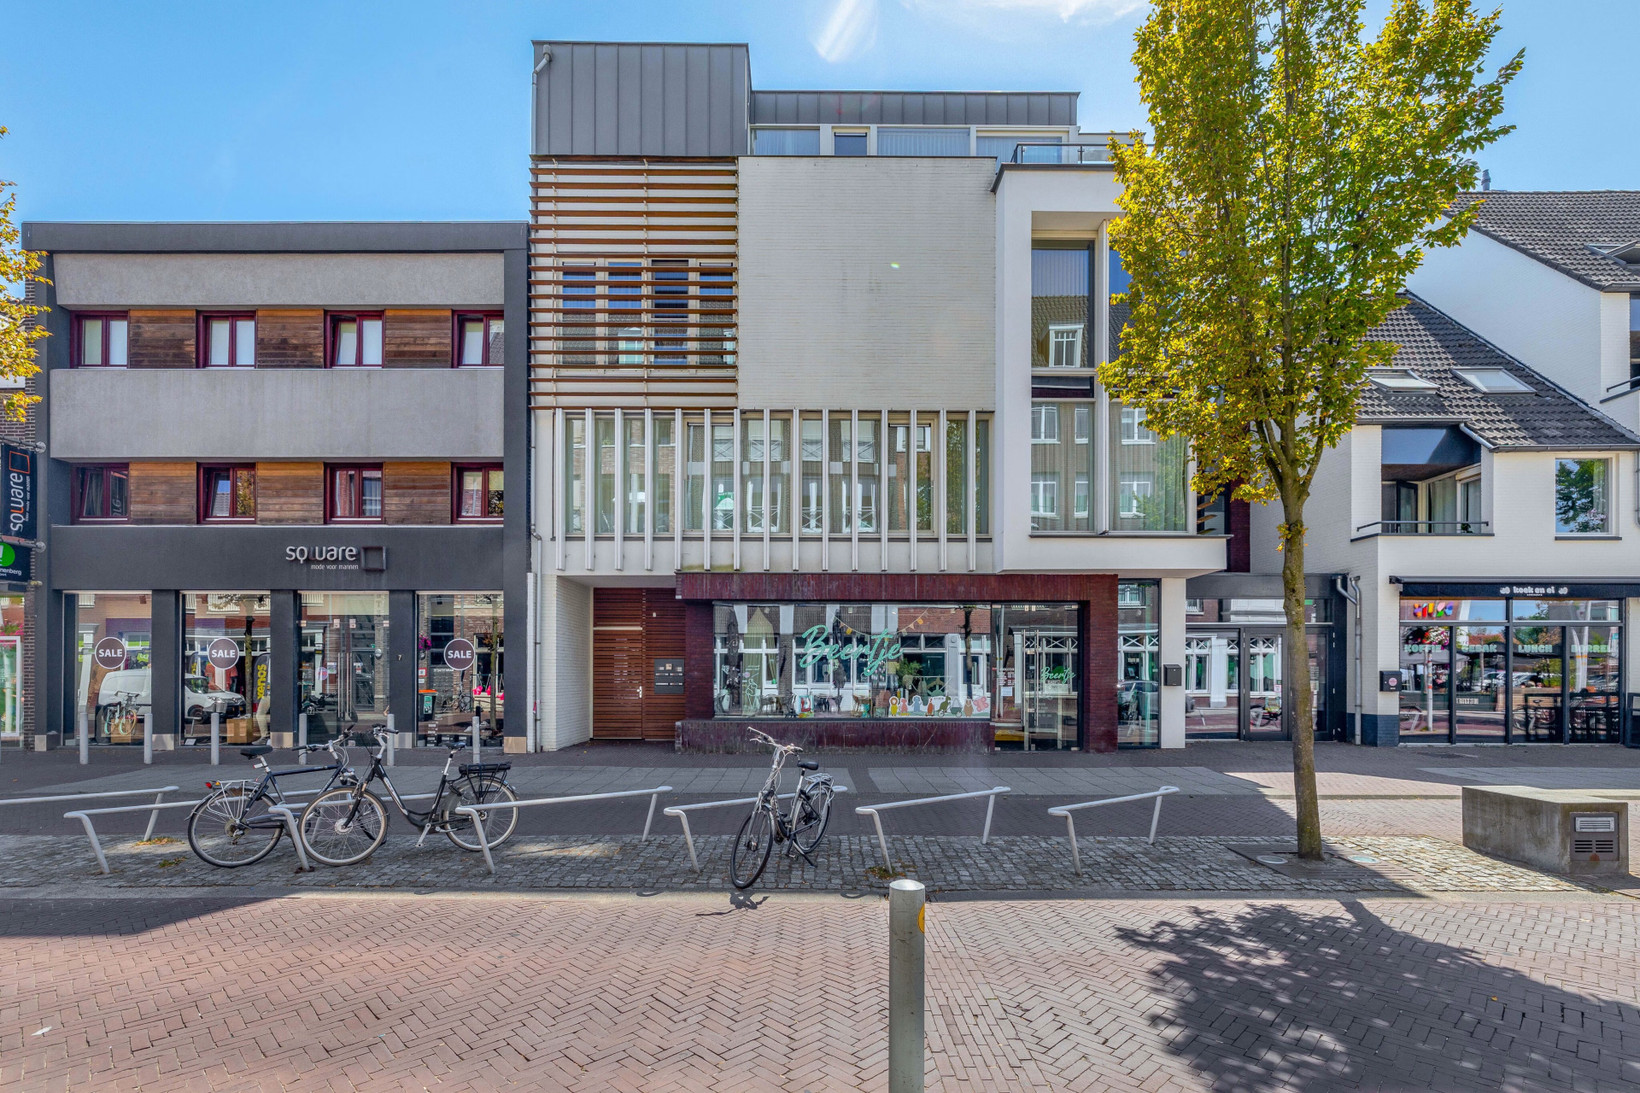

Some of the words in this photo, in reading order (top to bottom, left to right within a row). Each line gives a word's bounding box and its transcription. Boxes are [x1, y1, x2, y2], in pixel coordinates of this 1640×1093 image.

[285, 545, 358, 564] square
[1513, 586, 1534, 594] koek
[1546, 586, 1555, 594] ei
[98, 648, 123, 658] SALE
[211, 649, 236, 658] SALE
[800, 624, 904, 677] Beertje
[1403, 644, 1442, 653] KOFFIE
[1461, 644, 1498, 653] GEBAK
[1517, 644, 1553, 653] LUNCH
[447, 650, 472, 659] SALE
[1040, 666, 1076, 684] Beertje
[257, 663, 267, 700] xenos
